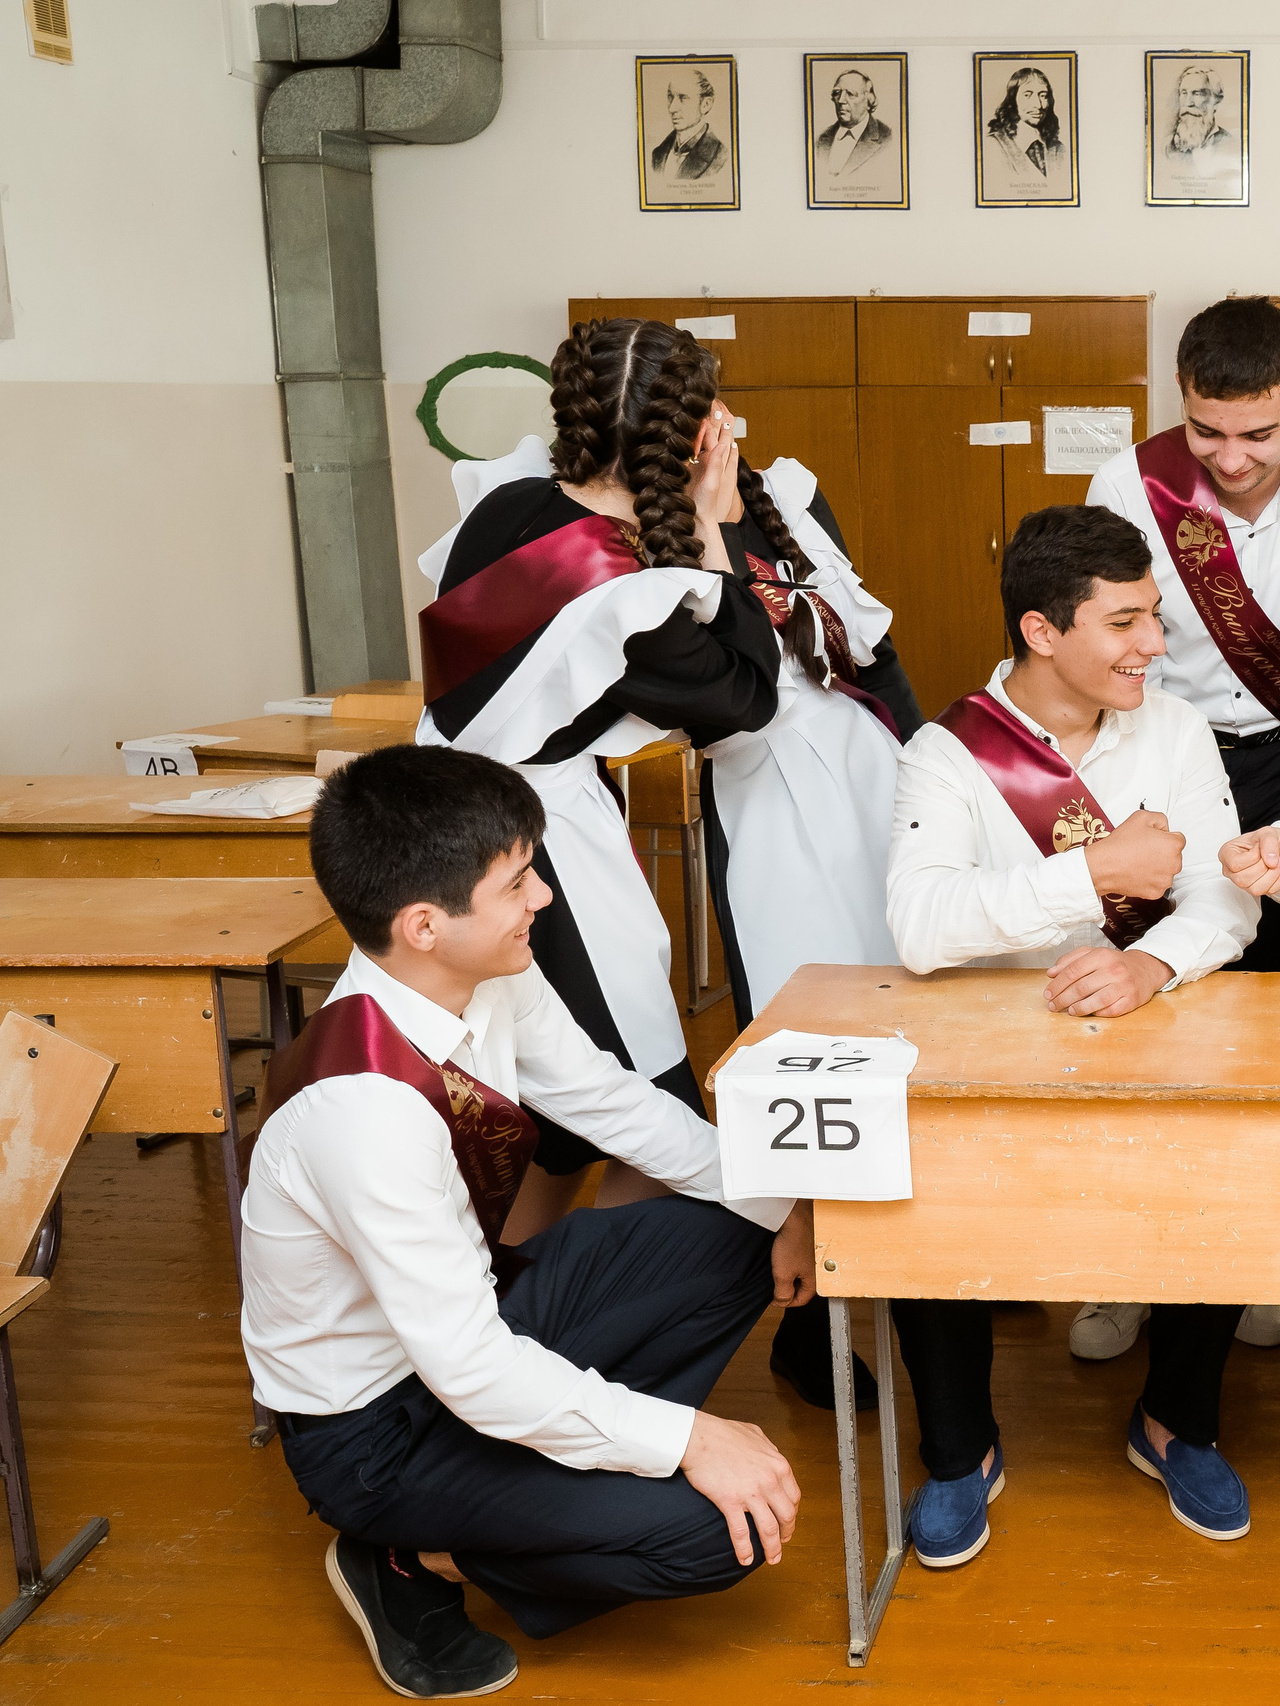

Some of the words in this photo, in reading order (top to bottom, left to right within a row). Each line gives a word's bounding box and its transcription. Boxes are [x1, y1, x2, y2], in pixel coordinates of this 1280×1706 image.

[1058, 446, 1121, 454] НАБЛЮДАТЕЛИ
[776, 1056, 872, 1073] 2Б
[768, 1097, 861, 1151] 2Б
